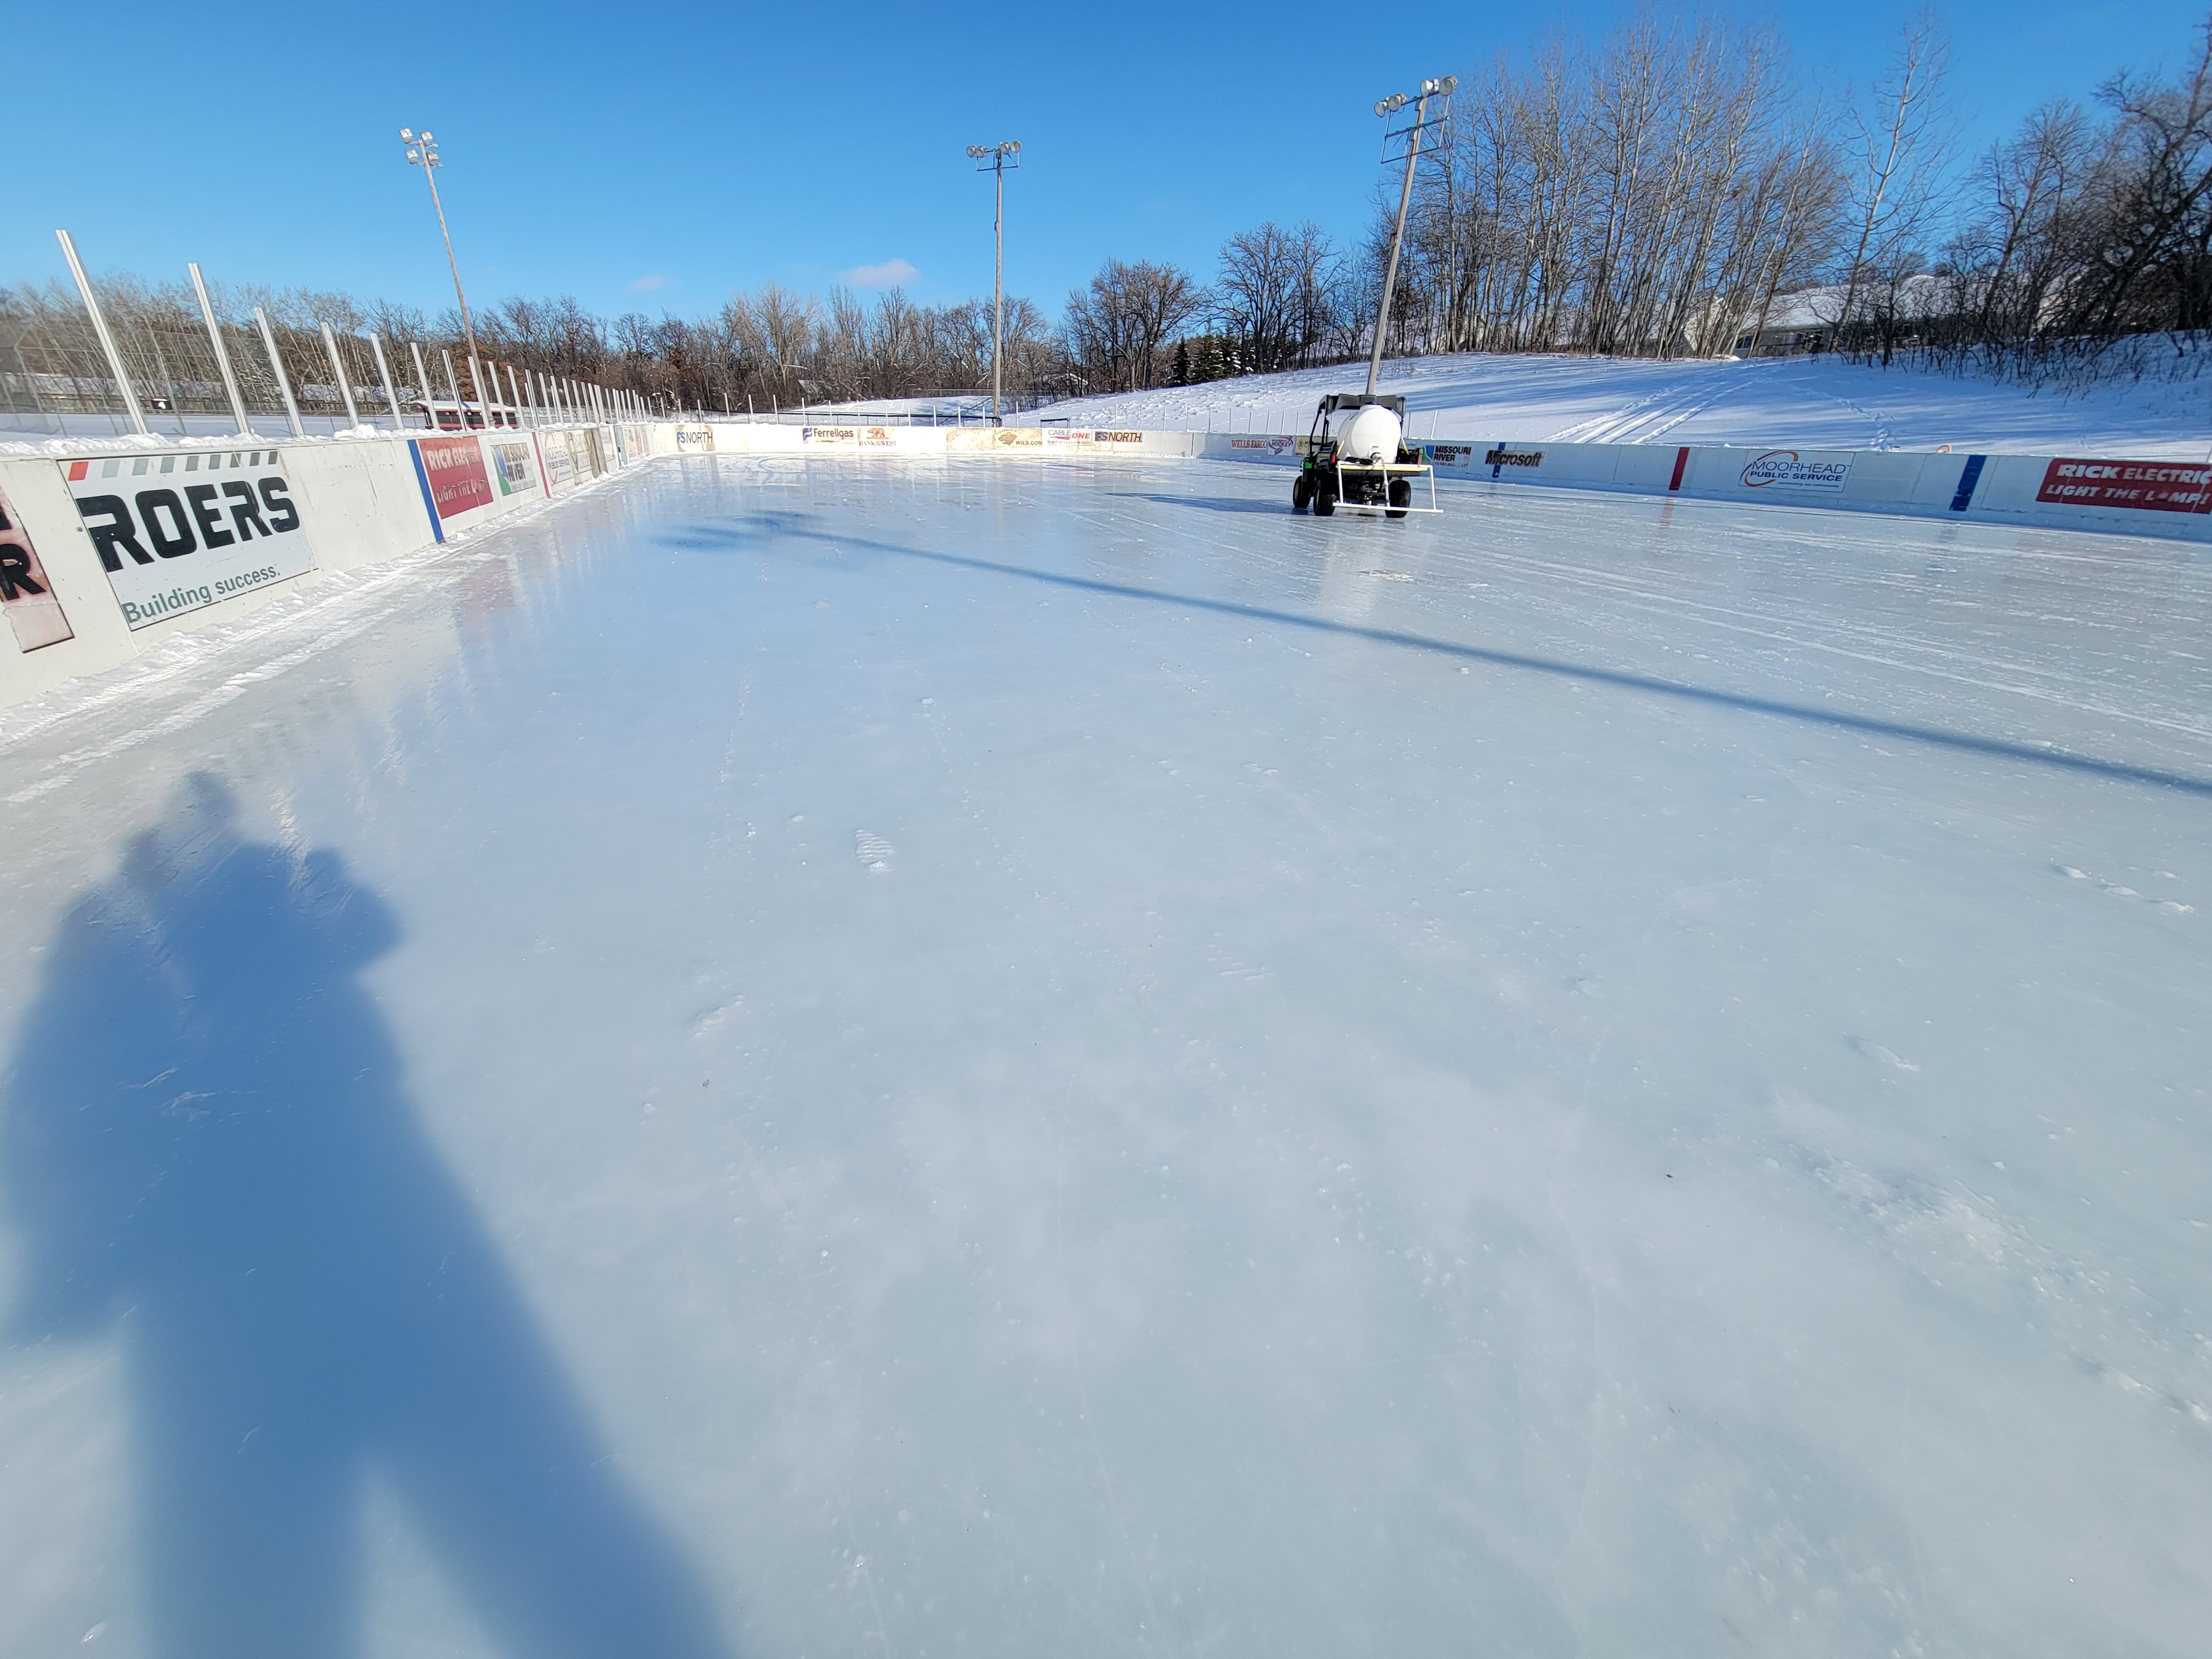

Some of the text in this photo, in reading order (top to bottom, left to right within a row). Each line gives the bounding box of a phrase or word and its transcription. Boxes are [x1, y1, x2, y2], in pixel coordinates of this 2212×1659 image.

[814, 428, 854, 439] Ferrellgas
[1232, 439, 1250, 448] WELLS
[1251, 440, 1267, 448] FARGO
[1435, 445, 1471, 454] MISSOURI
[426, 448, 455, 471] RICK
[1485, 450, 1542, 467] Microsoft
[1751, 461, 1846, 474] MOORHEAD
[2057, 464, 2212, 484] RICK ELECTRIC
[1792, 473, 1843, 482] SERVICE
[2045, 484, 2210, 505] LIGHT THE LMP!
[76, 477, 300, 572] ROERS
[122, 565, 280, 624] Building success.
